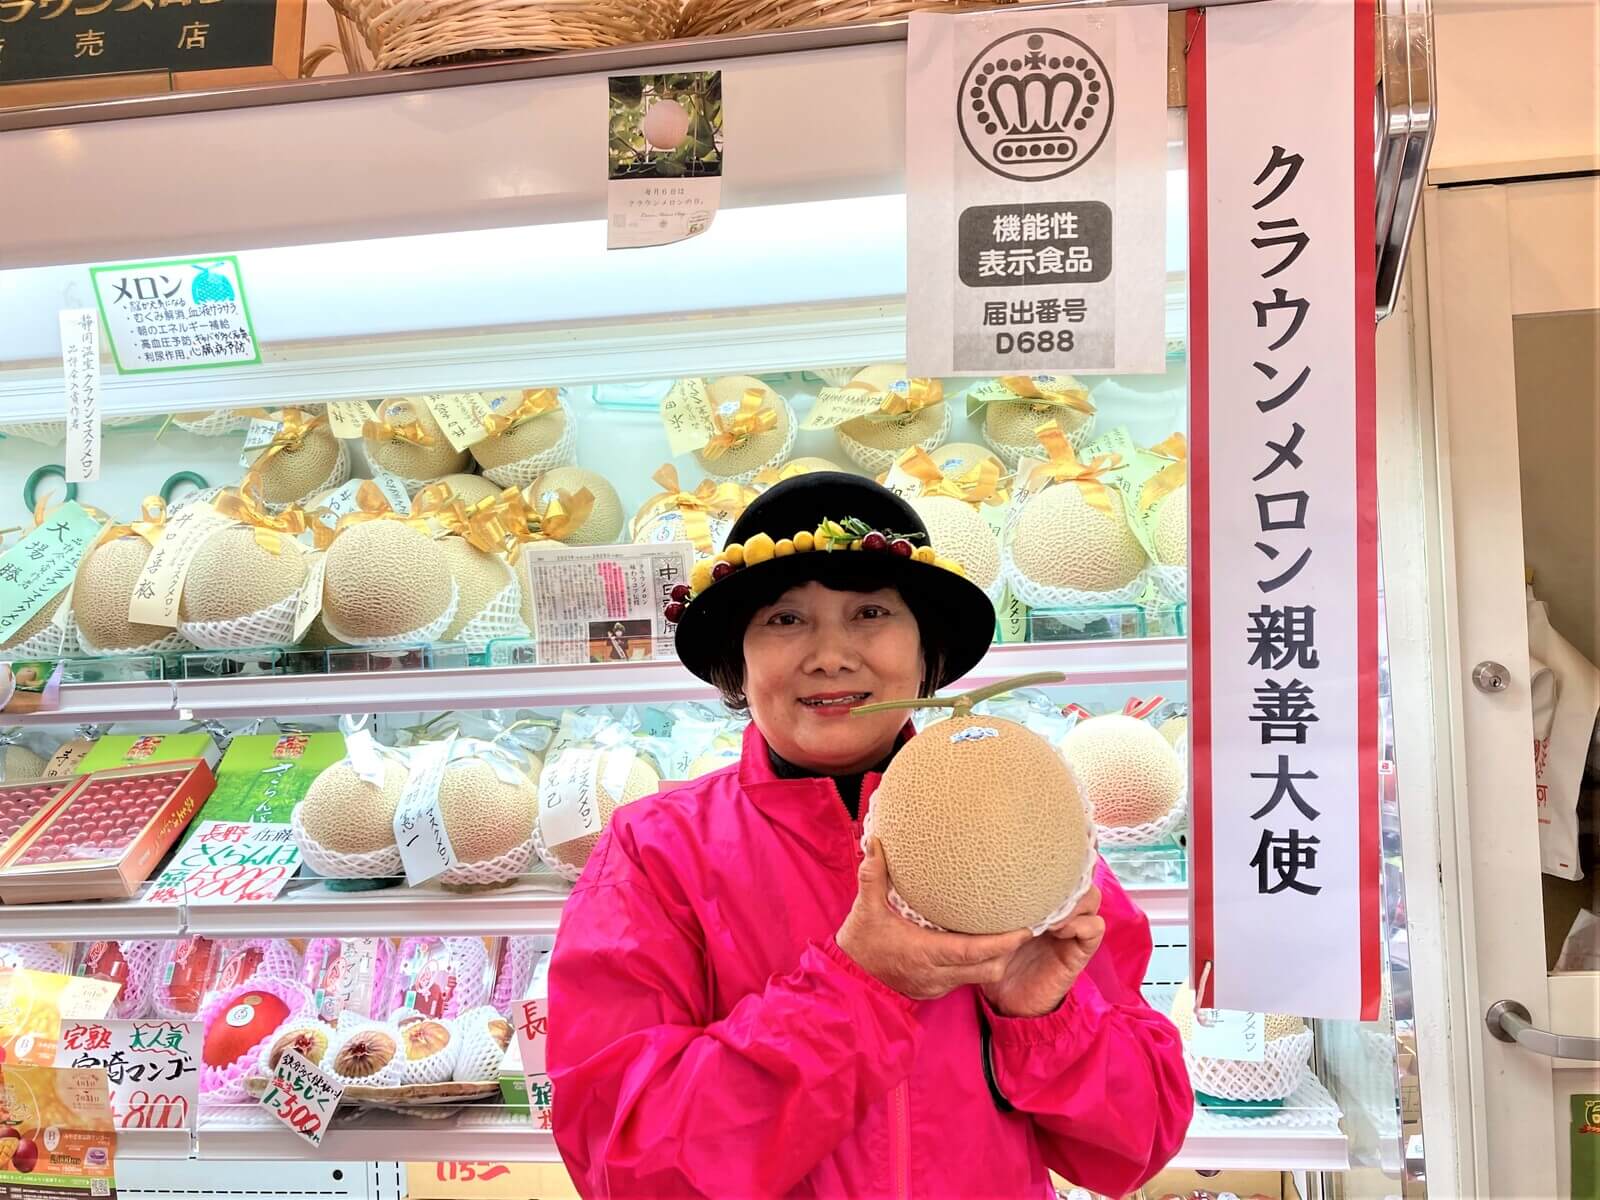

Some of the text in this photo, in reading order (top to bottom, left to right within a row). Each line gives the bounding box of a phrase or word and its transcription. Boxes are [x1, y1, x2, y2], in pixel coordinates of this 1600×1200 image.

[993, 212, 1078, 242] 機能性
[979, 246, 1093, 277] 表示食品
[112, 275, 182, 304] メロン
[983, 298, 1087, 326] 届出番号
[996, 330, 1074, 354] D688
[1246, 145, 1321, 896] クラウンメロン親善大使
[198, 823, 251, 843] 長野
[63, 1023, 187, 1053] 完熟 大人気
[277, 1094, 321, 1132] 500
